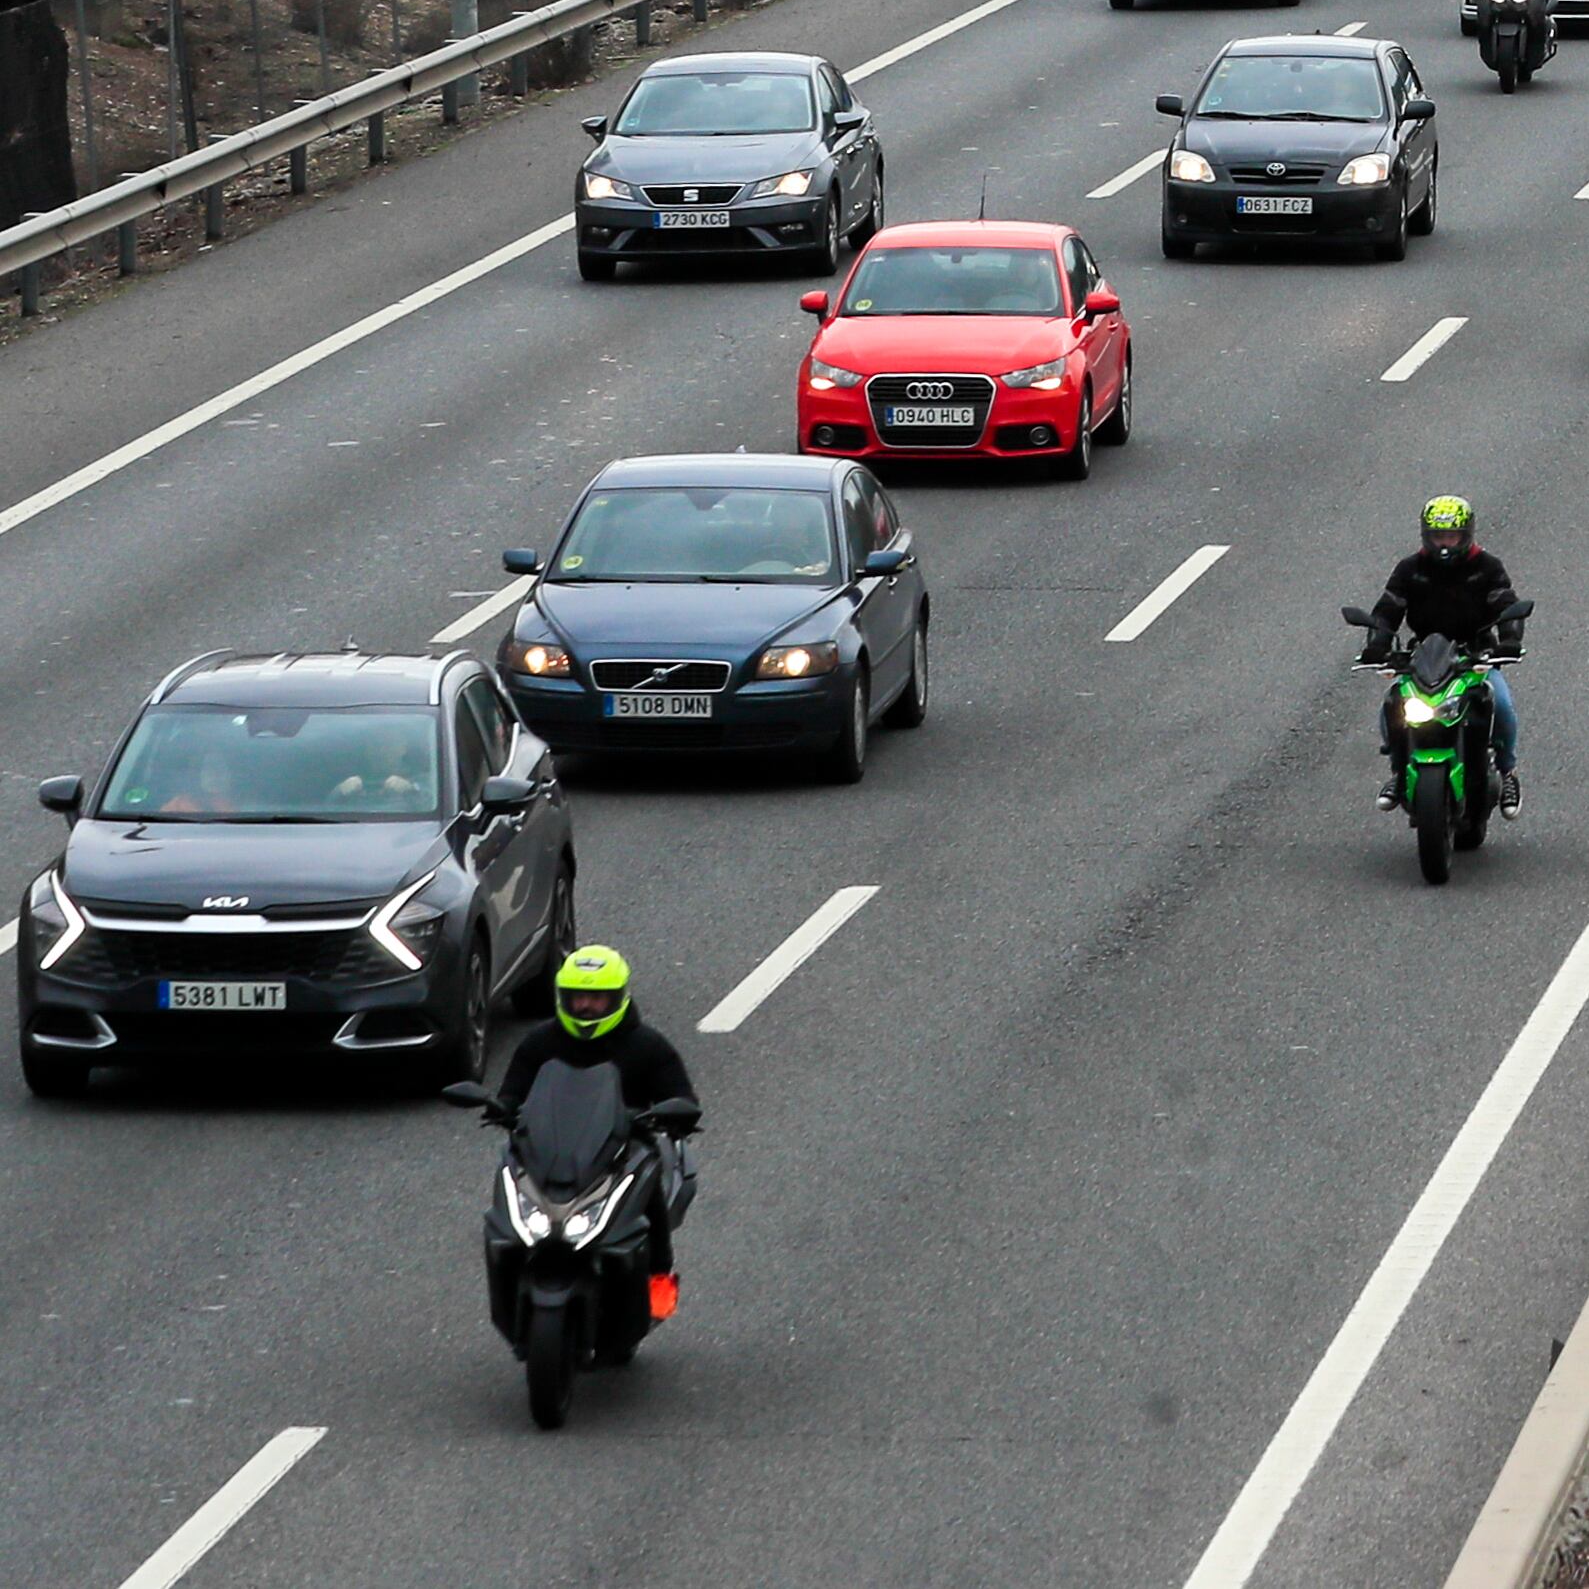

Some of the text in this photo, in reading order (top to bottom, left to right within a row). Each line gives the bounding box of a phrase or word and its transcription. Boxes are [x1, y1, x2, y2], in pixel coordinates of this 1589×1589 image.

[1244, 198, 1310, 212] 0631 FCZ
[662, 212, 729, 227] 2730 KCG
[895, 407, 972, 425] 0940 HLC
[617, 697, 709, 715] 5108 DMN
[173, 986, 282, 1007] 5381 LWT
